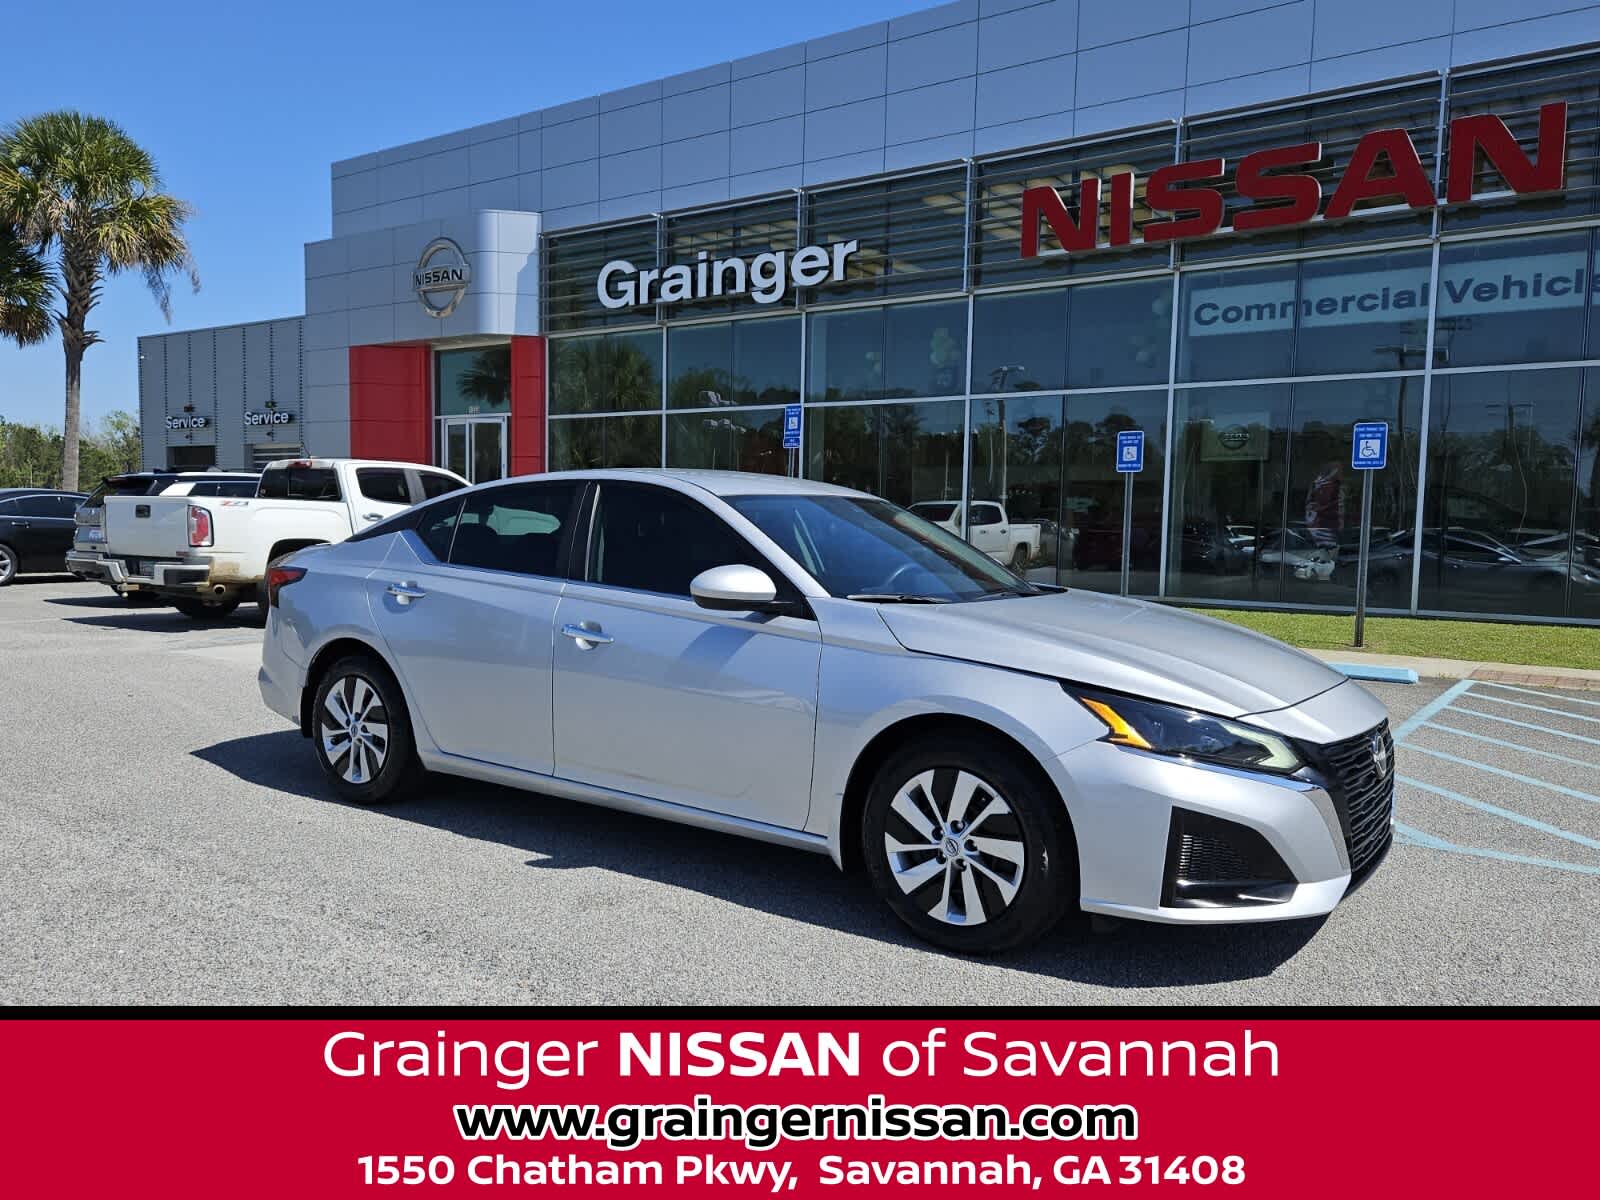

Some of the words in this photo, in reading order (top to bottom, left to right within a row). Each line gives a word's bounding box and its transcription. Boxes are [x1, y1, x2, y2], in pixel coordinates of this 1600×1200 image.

[1021, 101, 1568, 258] NISSAN
[415, 268, 463, 286] NISSAN
[597, 239, 859, 309] Grainger
[1194, 281, 1431, 326] Commercial
[166, 415, 206, 429] Service
[244, 411, 289, 425] Service
